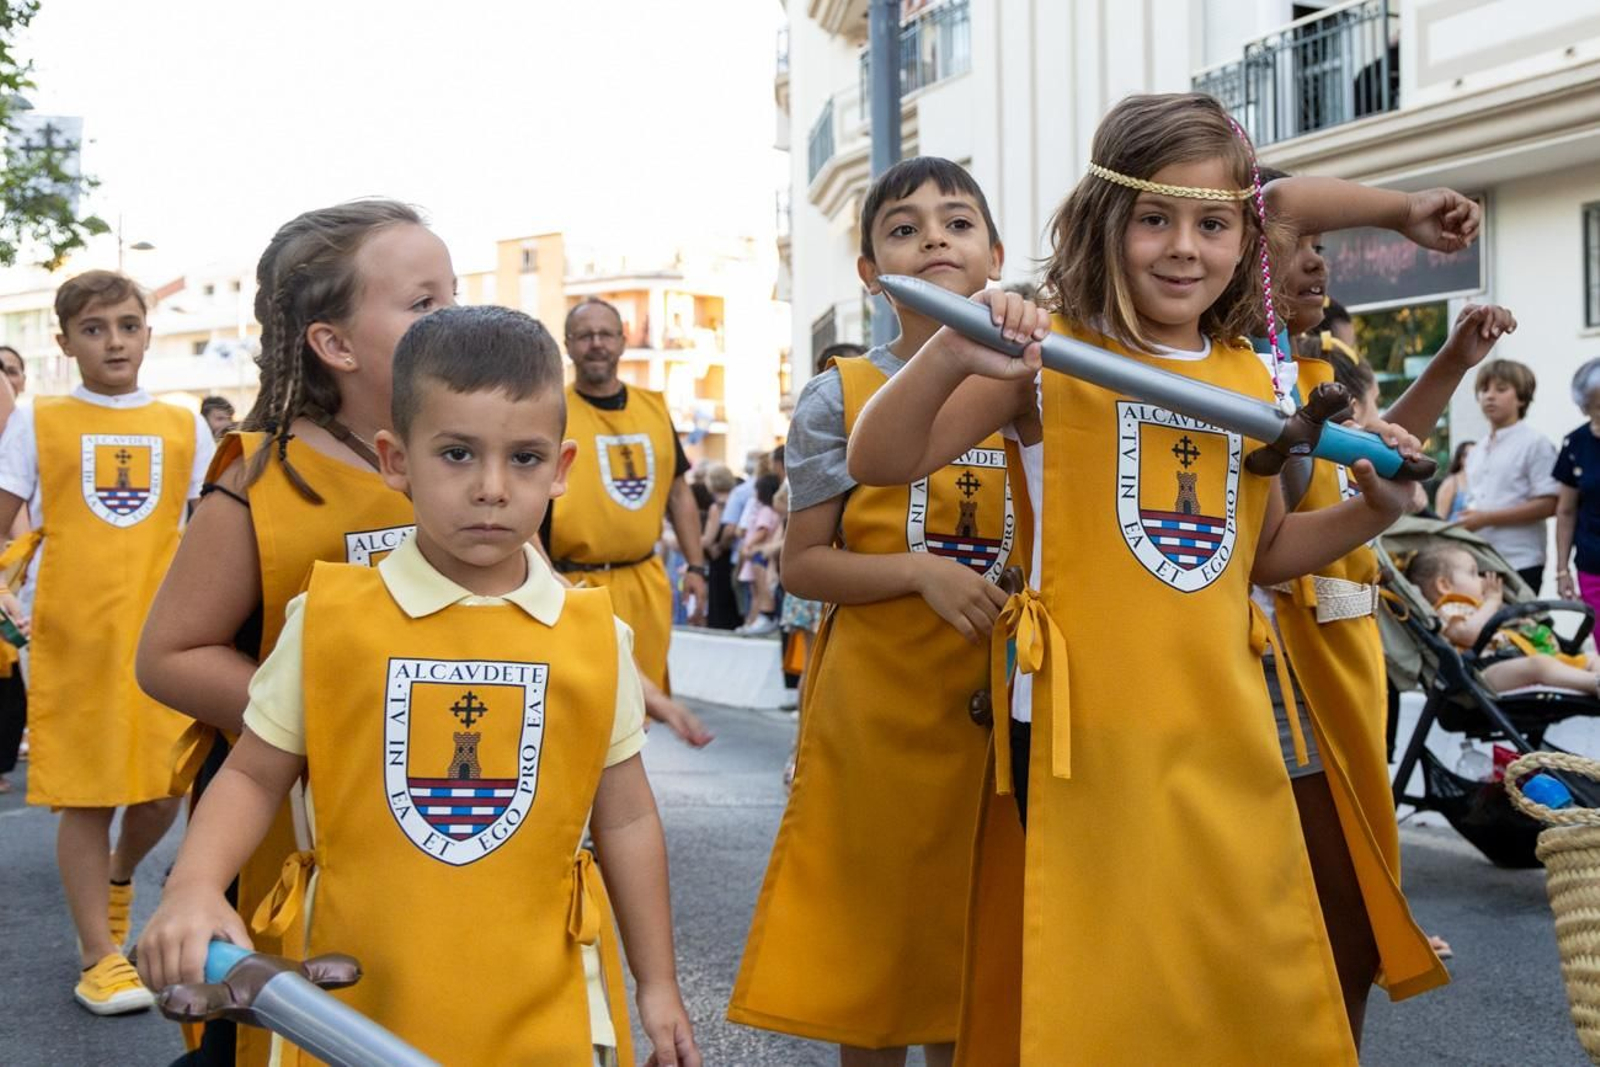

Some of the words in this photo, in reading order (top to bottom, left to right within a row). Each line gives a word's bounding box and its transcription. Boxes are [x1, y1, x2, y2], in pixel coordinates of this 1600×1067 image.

[1121, 431, 1137, 461] TV
[1121, 475, 1136, 499] IN
[1227, 489, 1236, 535] PRO
[911, 504, 925, 523] IN
[1002, 514, 1014, 552] PRO
[1123, 522, 1145, 550] EA
[1155, 560, 1184, 584] ET
[1201, 544, 1229, 583] EGO
[395, 663, 544, 684] ALCAVDETE
[390, 692, 407, 726] TV
[527, 700, 542, 728] EA
[389, 741, 405, 766] IN
[520, 744, 537, 794] PRO
[391, 790, 412, 821] EA
[422, 832, 456, 857] ET
[478, 807, 522, 852] EGO
